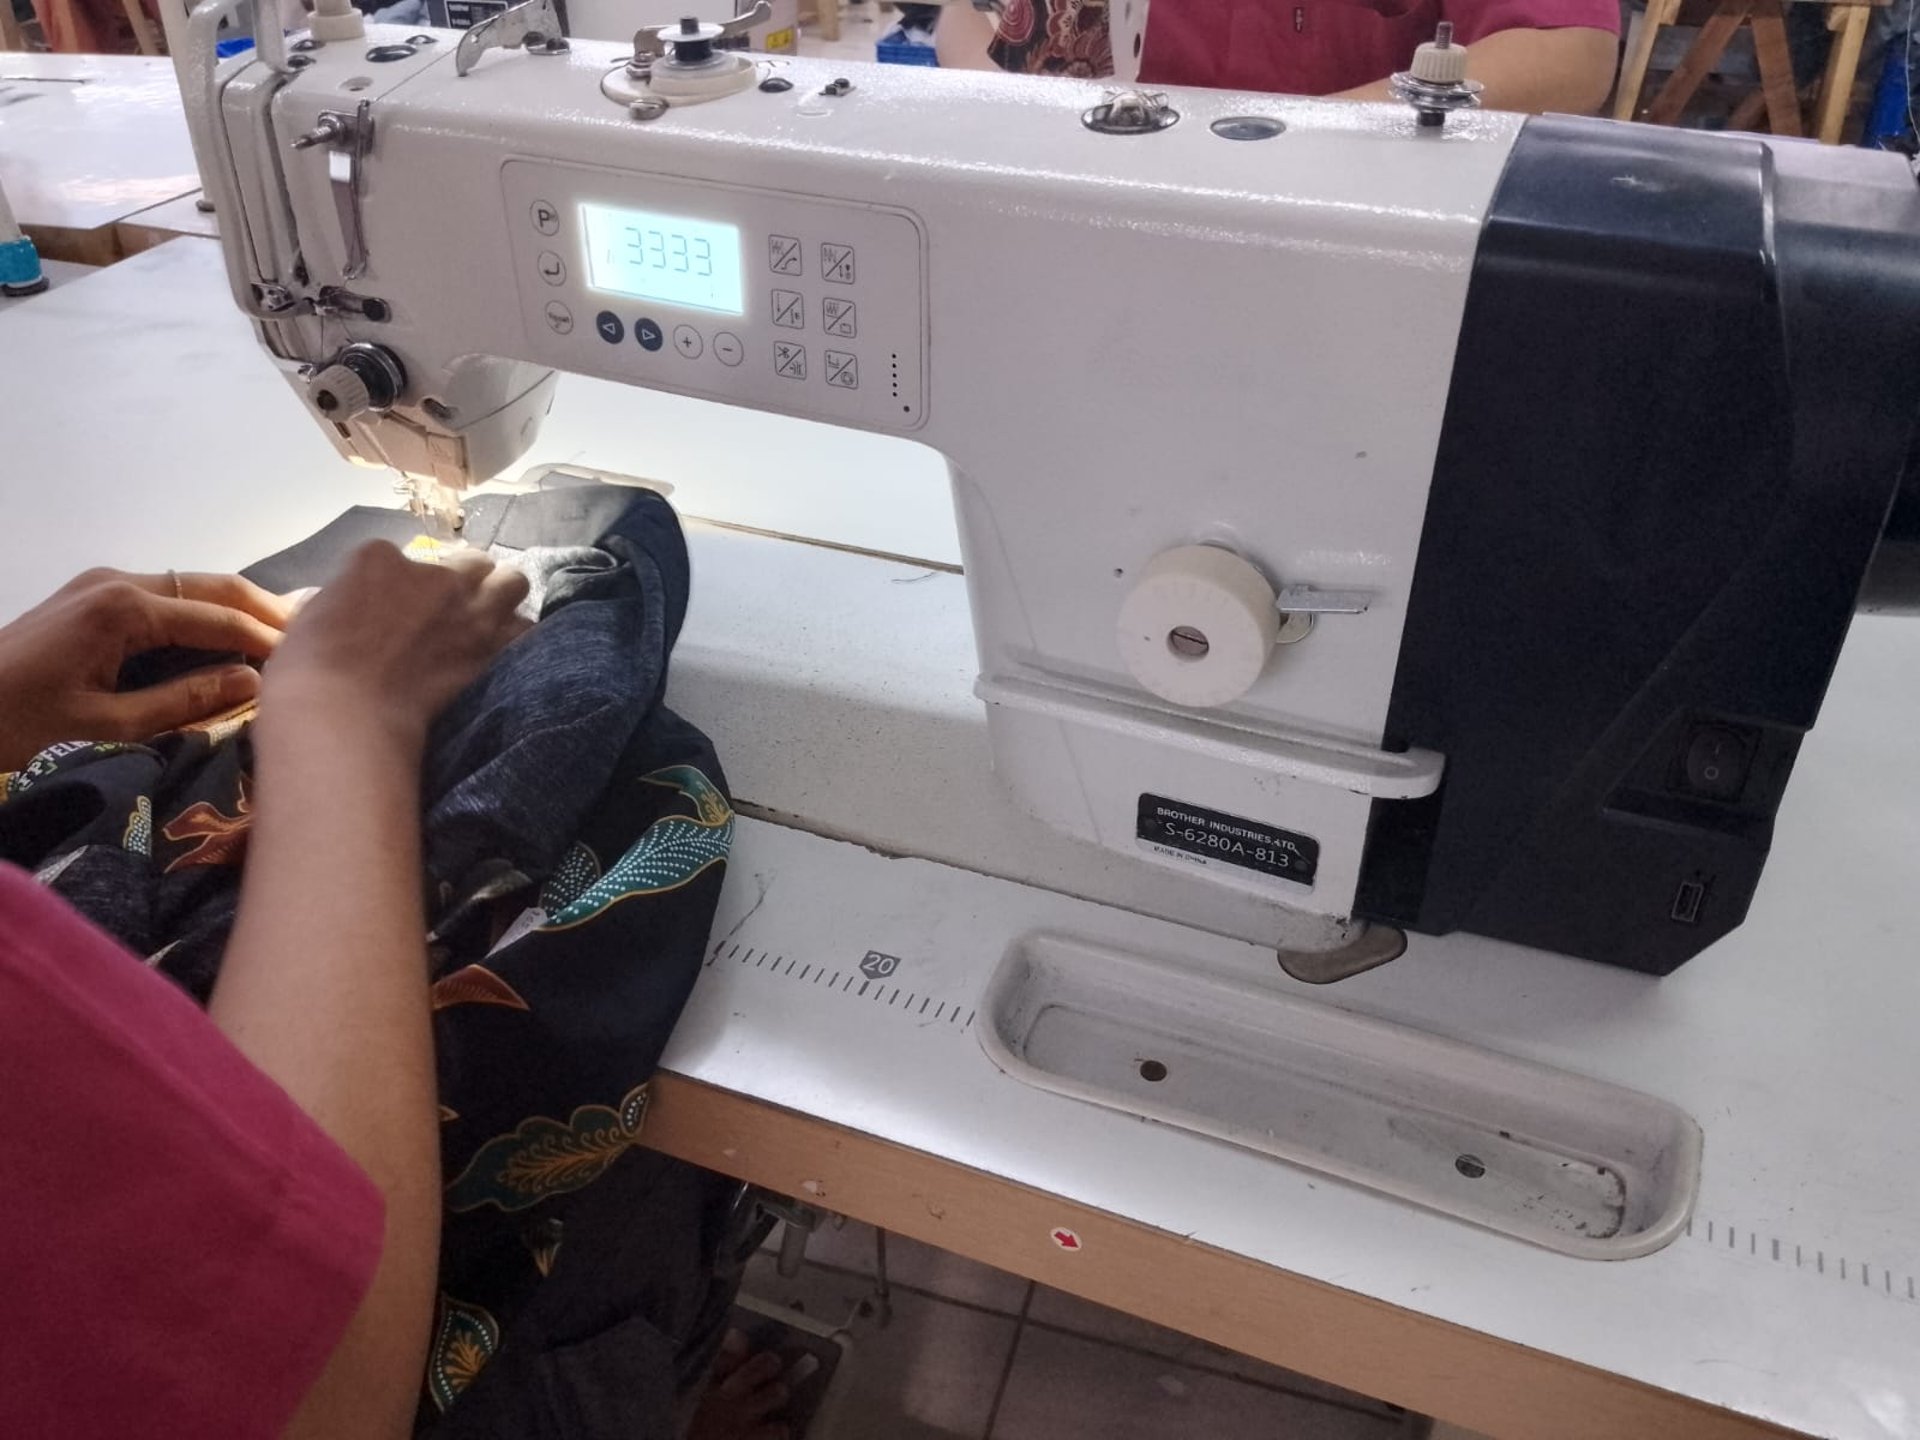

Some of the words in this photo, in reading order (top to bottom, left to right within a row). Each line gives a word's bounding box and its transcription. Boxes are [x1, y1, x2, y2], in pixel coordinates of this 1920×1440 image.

[538, 208, 551, 228] P
[624, 226, 713, 277] 3333
[1156, 806, 1206, 827] BROTHER
[1164, 822, 1290, 867] S-6280A-813
[862, 953, 895, 975] 20
